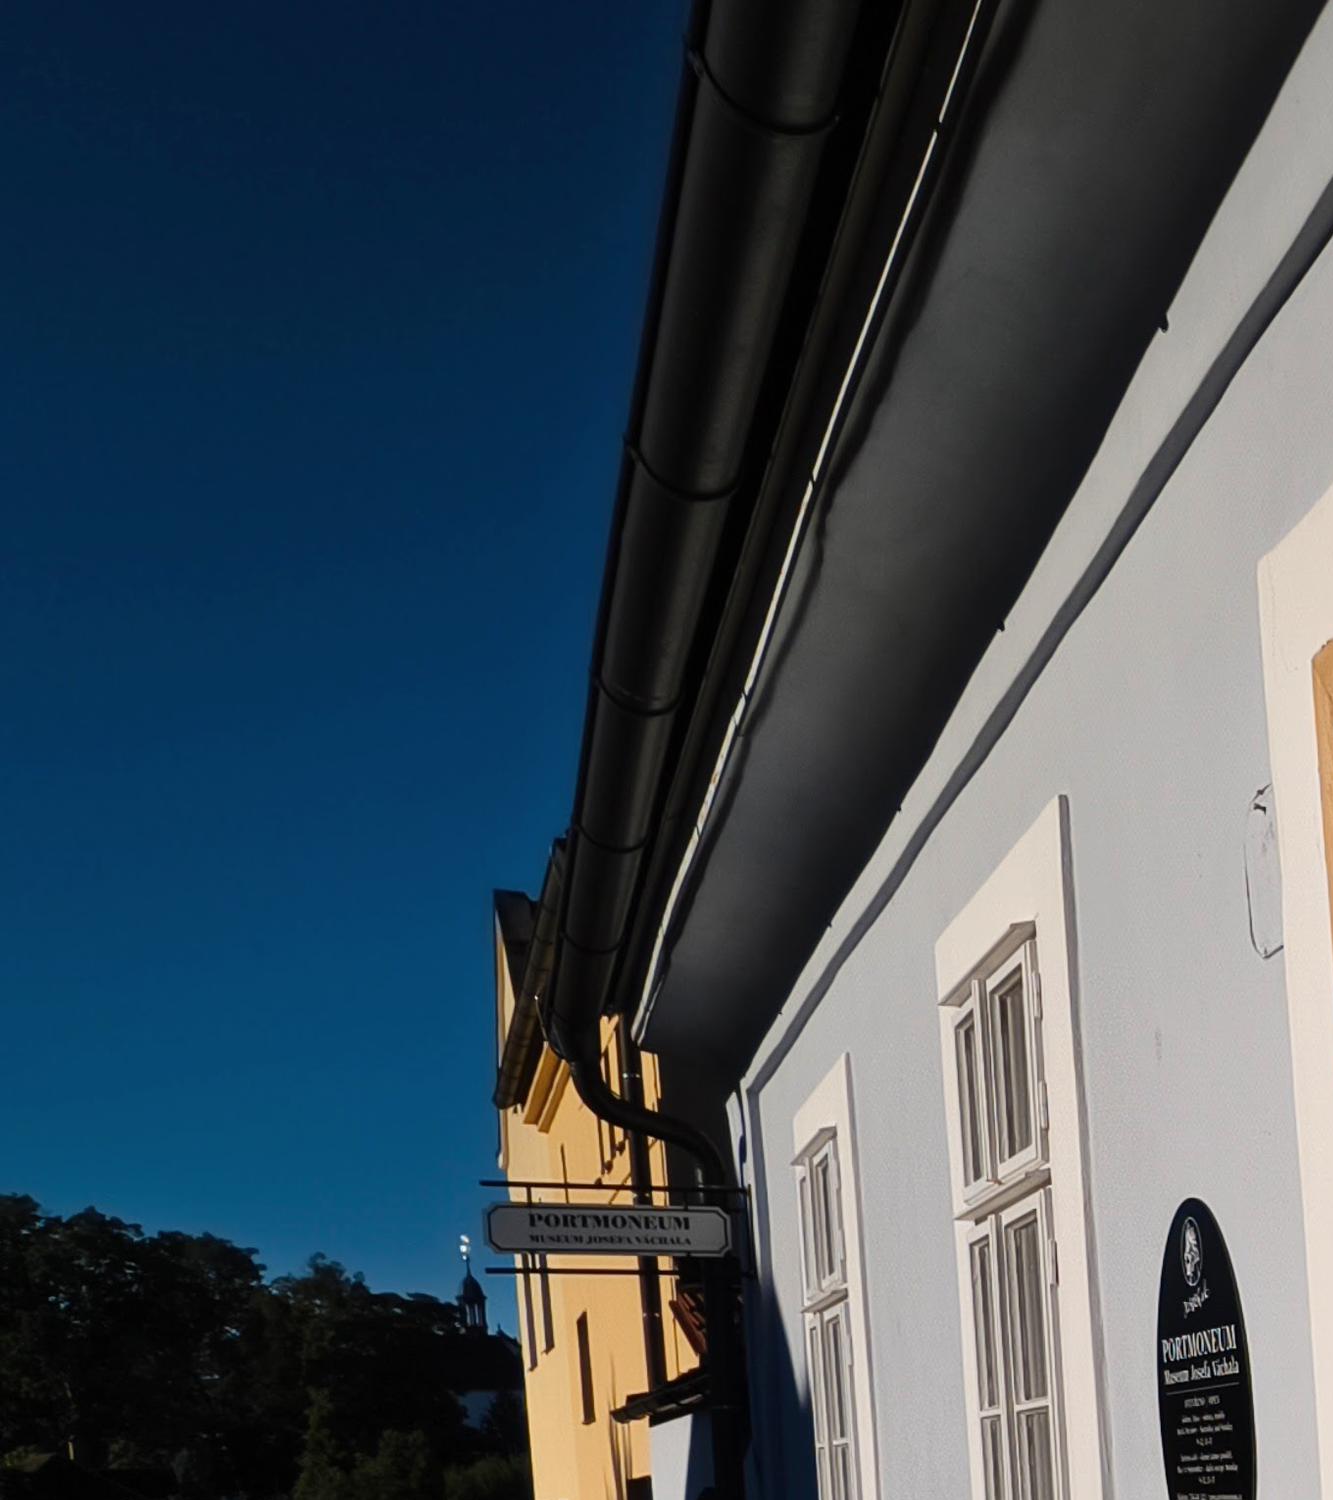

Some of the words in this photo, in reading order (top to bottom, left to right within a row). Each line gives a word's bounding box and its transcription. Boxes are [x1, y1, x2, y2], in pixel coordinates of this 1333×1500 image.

[528, 1212, 691, 1231] PORTMONEUM
[529, 1234, 584, 1245] MUSEUM
[586, 1234, 633, 1246] JOSEFA
[1161, 1324, 1238, 1363] PORTMONEUM
